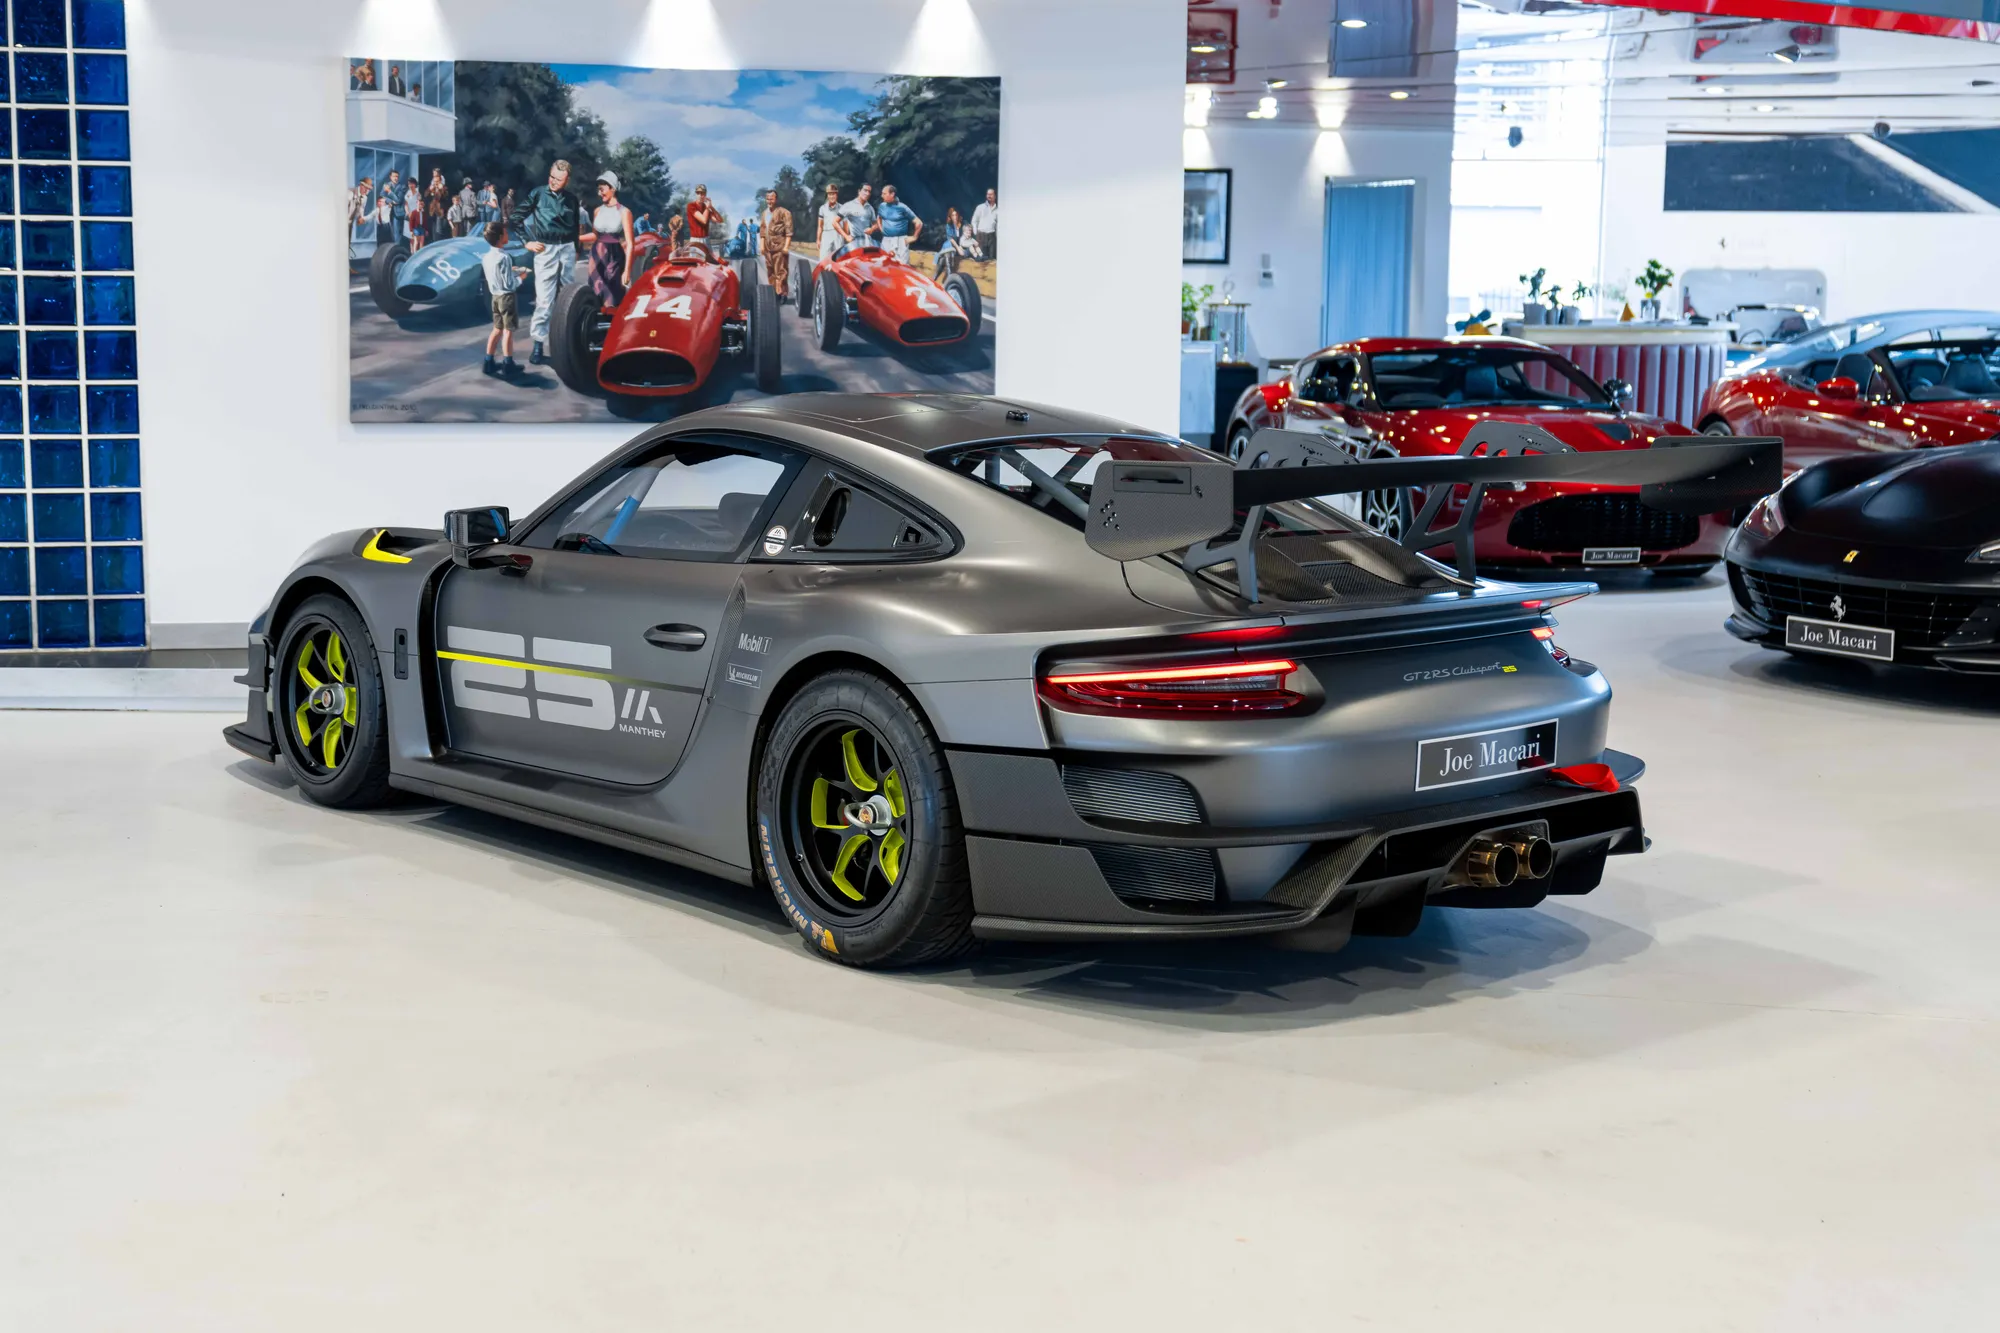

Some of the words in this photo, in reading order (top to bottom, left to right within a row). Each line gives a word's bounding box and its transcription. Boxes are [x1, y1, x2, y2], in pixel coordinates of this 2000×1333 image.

[624, 294, 692, 321] 14
[905, 286, 939, 309] 2
[1591, 552, 1605, 560] Joe
[1606, 551, 1633, 560] Macari
[738, 633, 763, 652] Mobil
[1800, 625, 1824, 643] Joe
[1827, 628, 1877, 650] Macari
[1452, 662, 1501, 676] Clubsport
[619, 723, 667, 739] MANTHEY
[1439, 747, 1473, 777] Joe
[1479, 733, 1541, 767] Macari
[760, 824, 809, 930] MICHELIN
